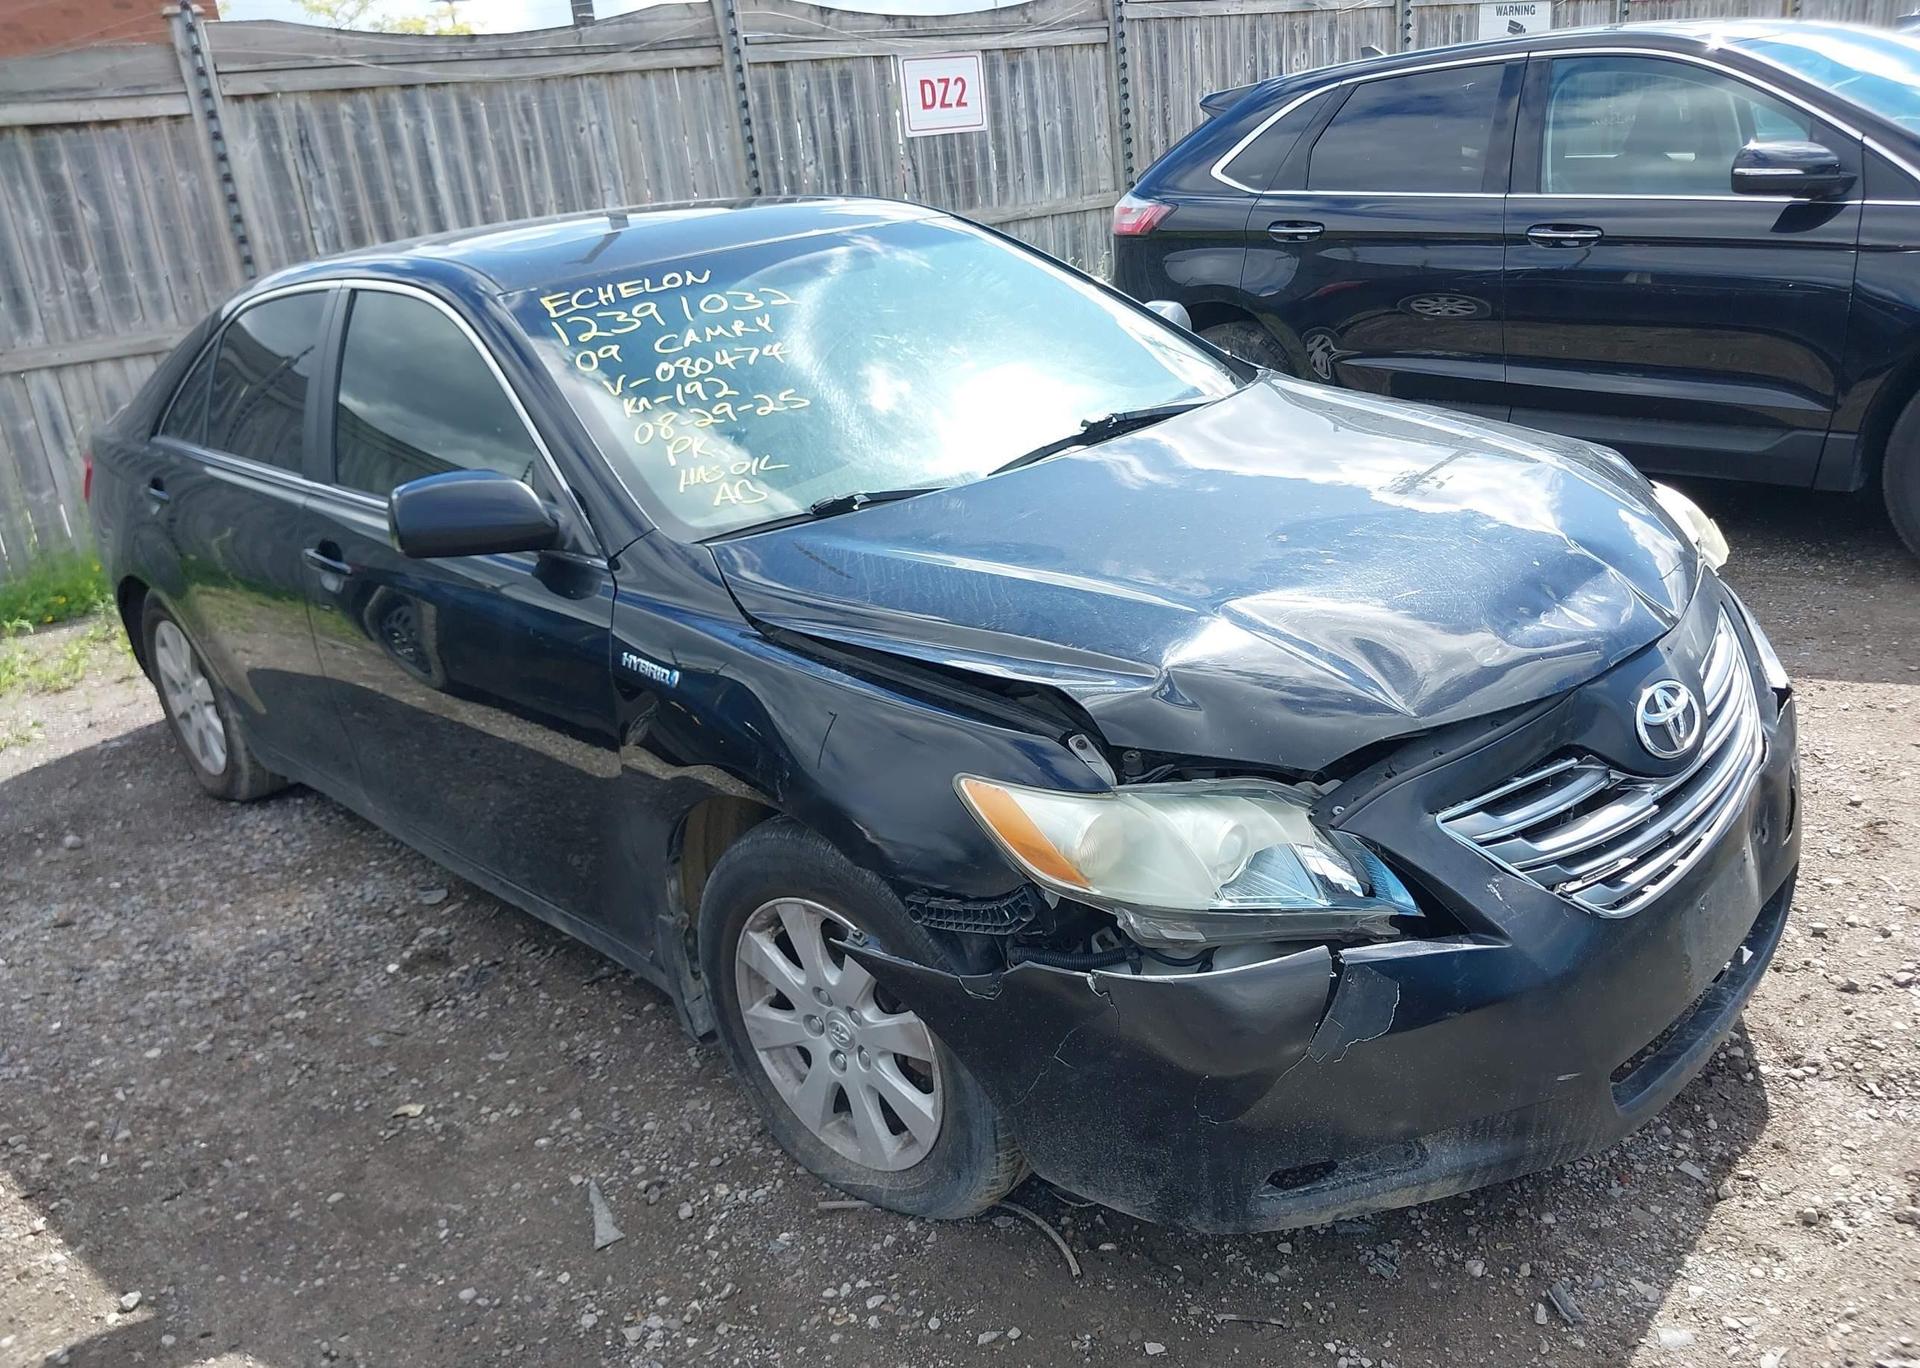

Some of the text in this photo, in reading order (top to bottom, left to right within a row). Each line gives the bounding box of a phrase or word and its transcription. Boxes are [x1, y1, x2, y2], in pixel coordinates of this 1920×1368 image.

[1495, 4, 1536, 17] WARNING
[919, 76, 968, 111] DZ2
[540, 269, 711, 318] ECHELON
[551, 287, 800, 346] 1239 1032
[575, 313, 774, 372] 09 CAMRY
[621, 652, 671, 685] HYBRID
